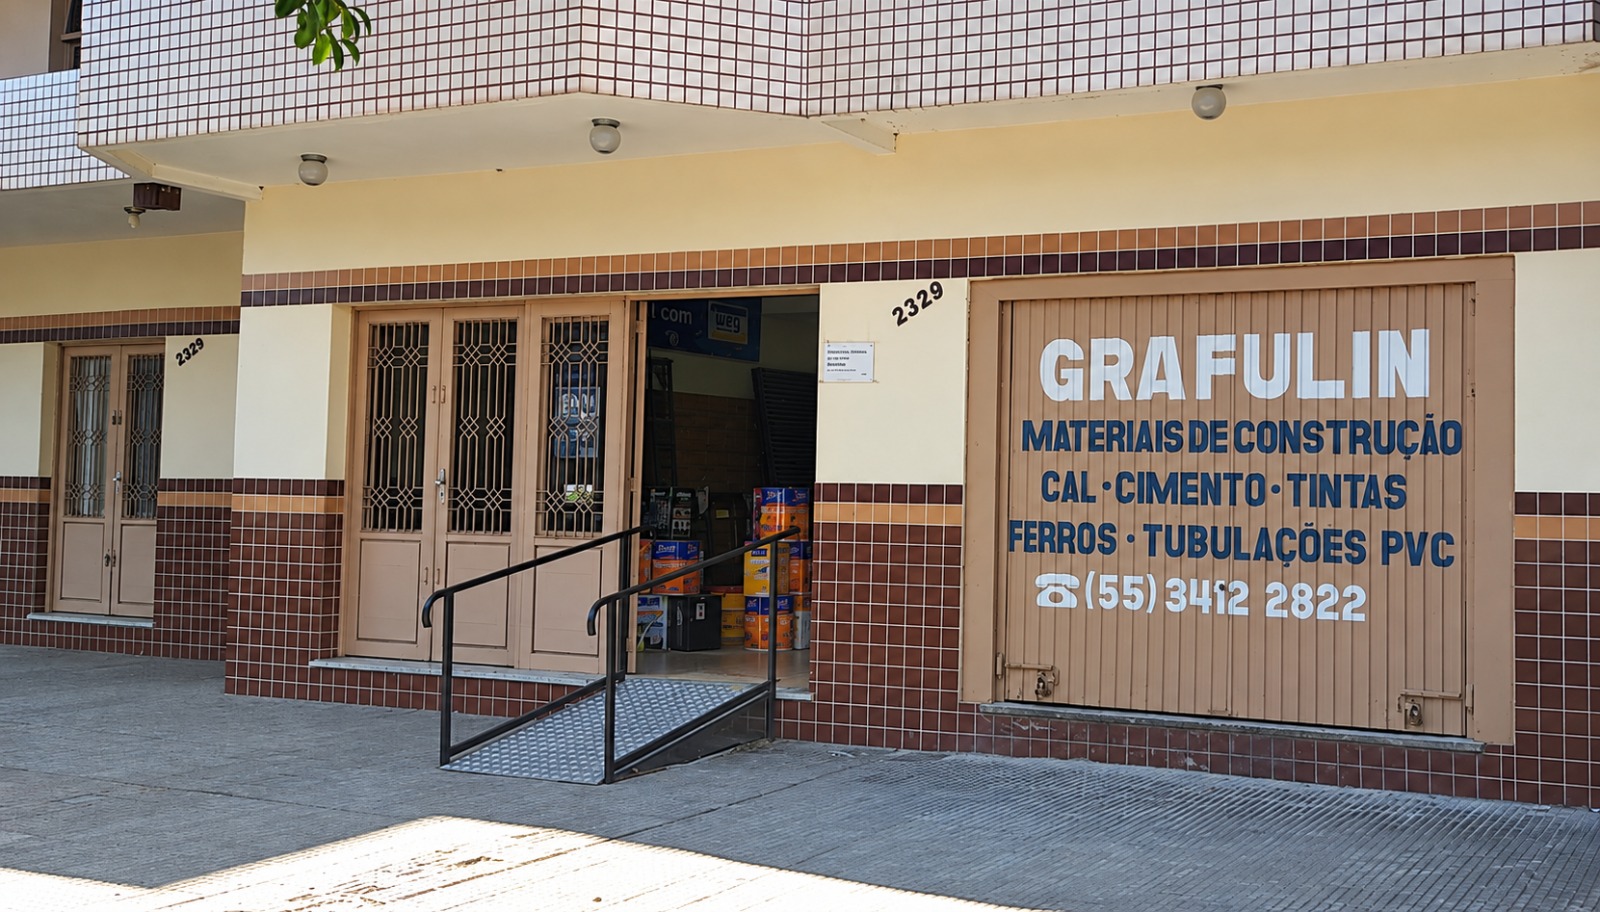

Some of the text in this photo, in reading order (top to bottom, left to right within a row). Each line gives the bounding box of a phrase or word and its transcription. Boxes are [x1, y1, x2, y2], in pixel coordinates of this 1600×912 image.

[660, 307, 693, 325] com
[715, 311, 741, 334] weg
[891, 281, 944, 327] 2329
[175, 337, 205, 367] 2329
[1039, 328, 1430, 402] GRAFULIN
[1022, 413, 1463, 461] MATERIAIS DE CONSTRUÇÃO
[1041, 470, 1407, 510] CAL CIMENTO TINTAS
[1008, 520, 1455, 567] FERROS TUBULAÇÕES PVC
[1085, 570, 1367, 622] (55) 3412 2822
